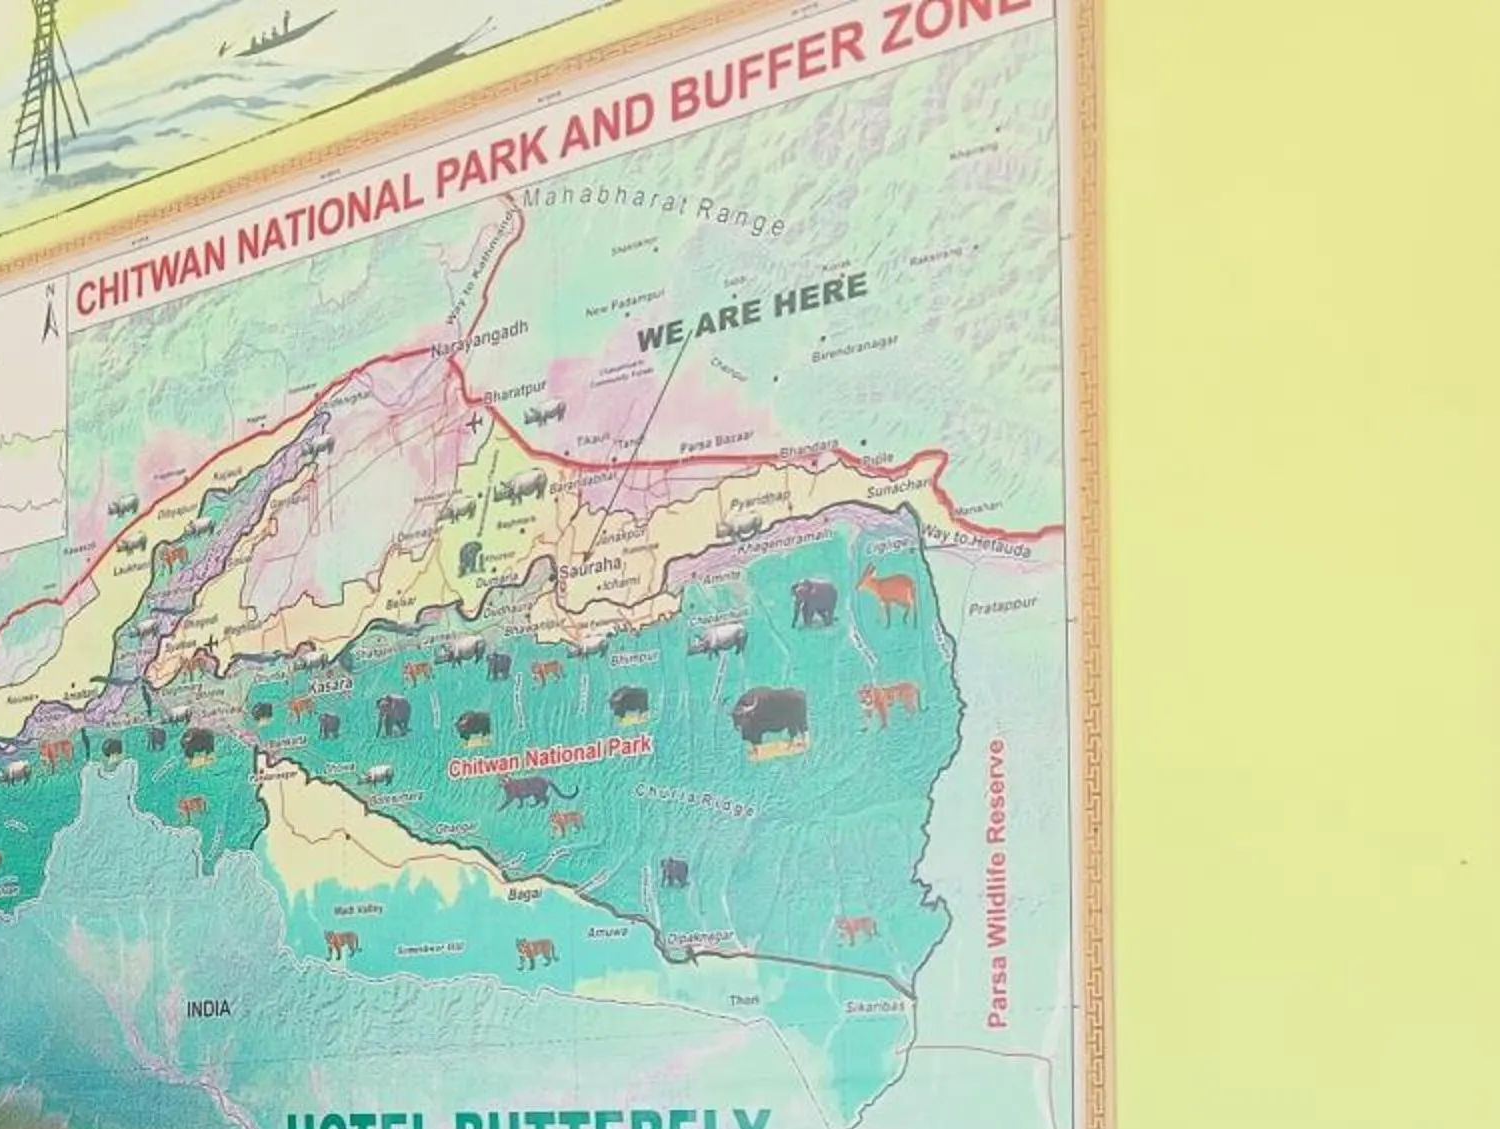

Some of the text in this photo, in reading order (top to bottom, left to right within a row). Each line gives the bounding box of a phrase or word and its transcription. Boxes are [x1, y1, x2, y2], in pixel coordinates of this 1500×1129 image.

[75, 234, 227, 318] CHITWAN
[236, 172, 426, 265] NATIONAL
[435, 125, 550, 200] PARK
[559, 91, 656, 160] AND
[670, 20, 868, 124] BUFFER
[522, 184, 787, 240] Mahabharat Range
[44, 285, 55, 297] N
[637, 272, 869, 353] WE ARE HERE
[430, 319, 529, 359] Narayangadh
[483, 379, 547, 406] Bharatpur
[921, 522, 957, 541] Way
[957, 531, 971, 545] to
[558, 556, 623, 579] Sauraha
[968, 596, 1039, 618] Pratappur
[309, 678, 354, 696] Kasara
[448, 734, 652, 779] Chitwan National Park
[986, 739, 1008, 1029] Parsa Wildlife Reserve
[187, 1000, 232, 1018] INDIA
